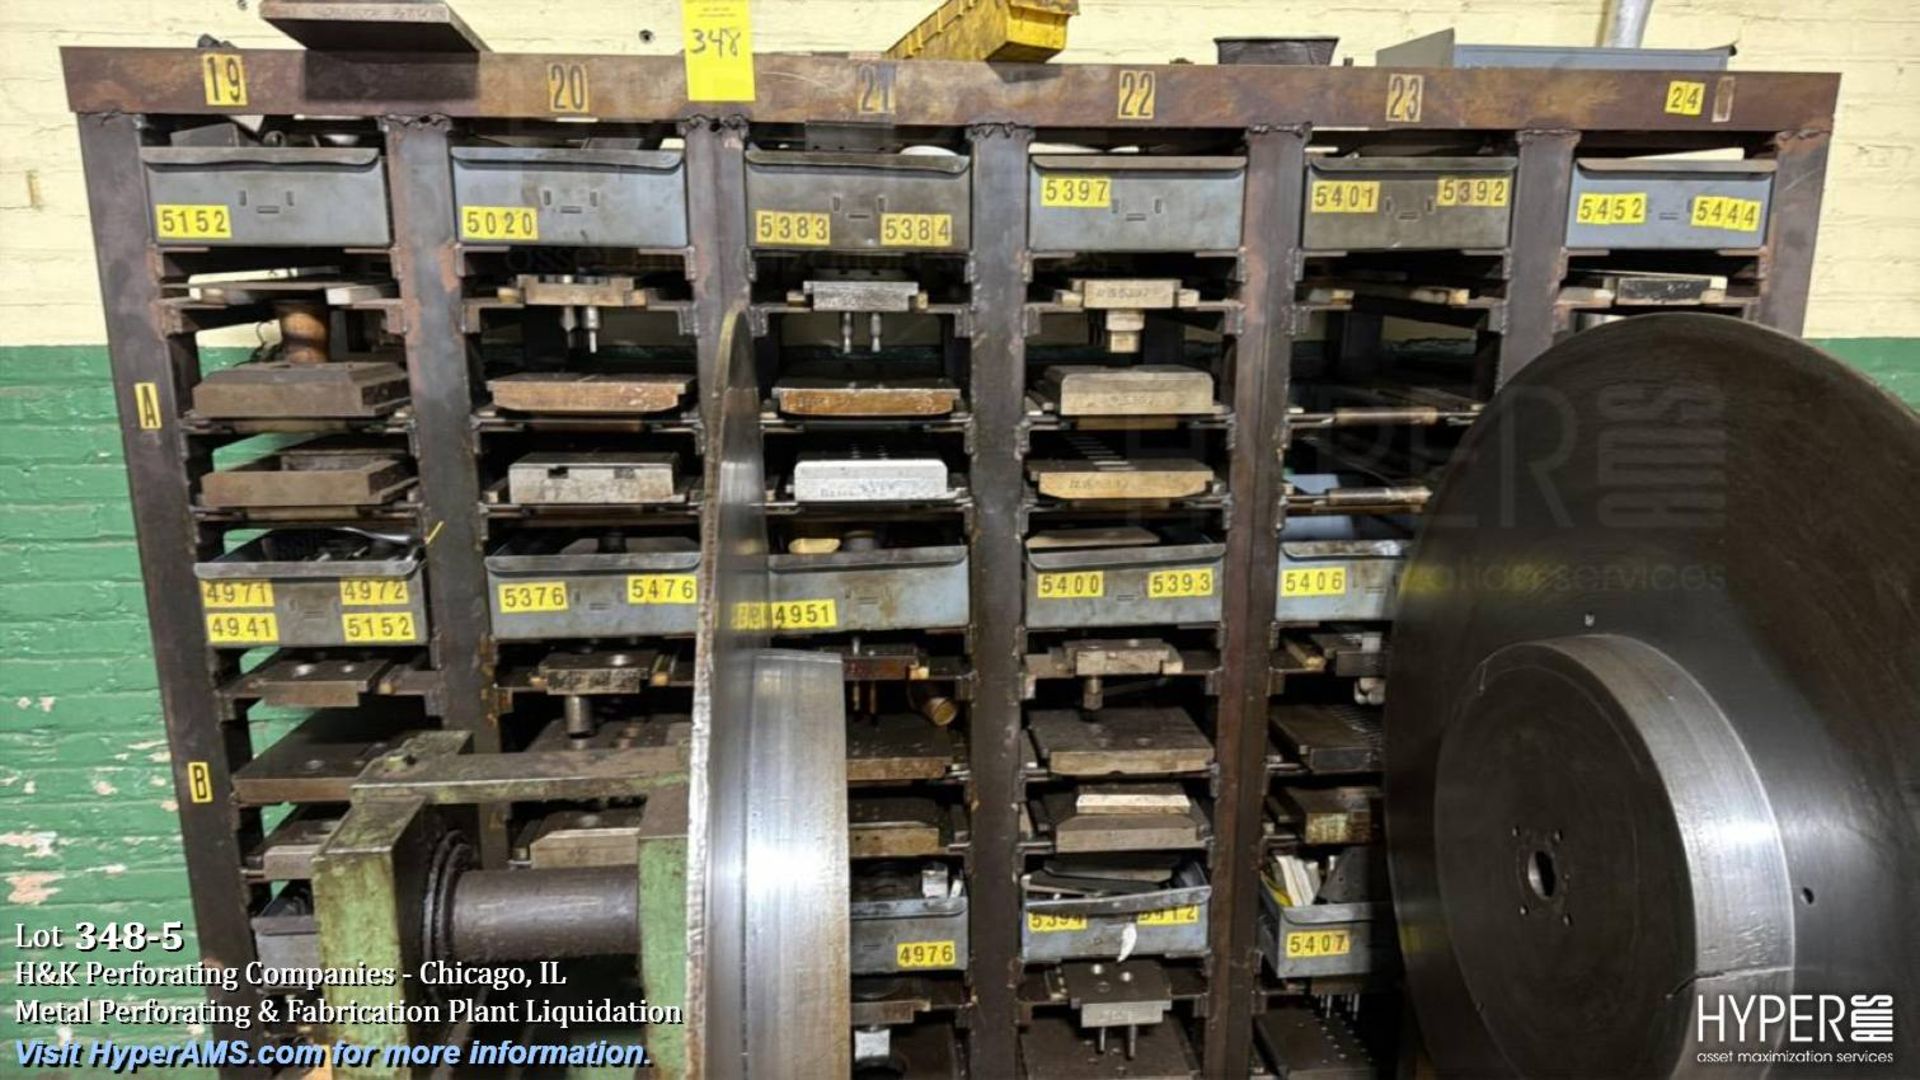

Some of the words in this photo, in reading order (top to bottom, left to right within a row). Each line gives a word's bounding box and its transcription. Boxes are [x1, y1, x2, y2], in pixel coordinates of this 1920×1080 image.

[690, 28, 741, 57] 348
[207, 57, 242, 102] 19
[552, 64, 585, 108] 20
[860, 65, 891, 111] 21
[1121, 72, 1152, 115] 22
[1389, 76, 1422, 120] 23
[1671, 87, 1700, 109] 24
[1045, 181, 1108, 203] 5397
[1315, 185, 1376, 208] 5401
[1443, 181, 1505, 203] 5392
[1579, 197, 1643, 221] 5452
[1695, 200, 1757, 226] 5444
[162, 212, 227, 234] 5152
[466, 212, 533, 235] 5020
[759, 214, 828, 240] 5383
[884, 216, 949, 242] 5384
[143, 388, 157, 426] A
[207, 583, 267, 603] 4971
[344, 580, 405, 600] 4972
[632, 579, 694, 599] 5476
[1042, 573, 1098, 595] 5400
[1152, 572, 1210, 594] 5393
[1286, 572, 1342, 592] 5406
[505, 587, 564, 607] 5376
[775, 604, 830, 624] 4951
[212, 617, 270, 637] 4941
[348, 617, 410, 637] 5152
[195, 765, 207, 799] B
[900, 943, 952, 964] 4976
[1290, 934, 1345, 953] 5407
